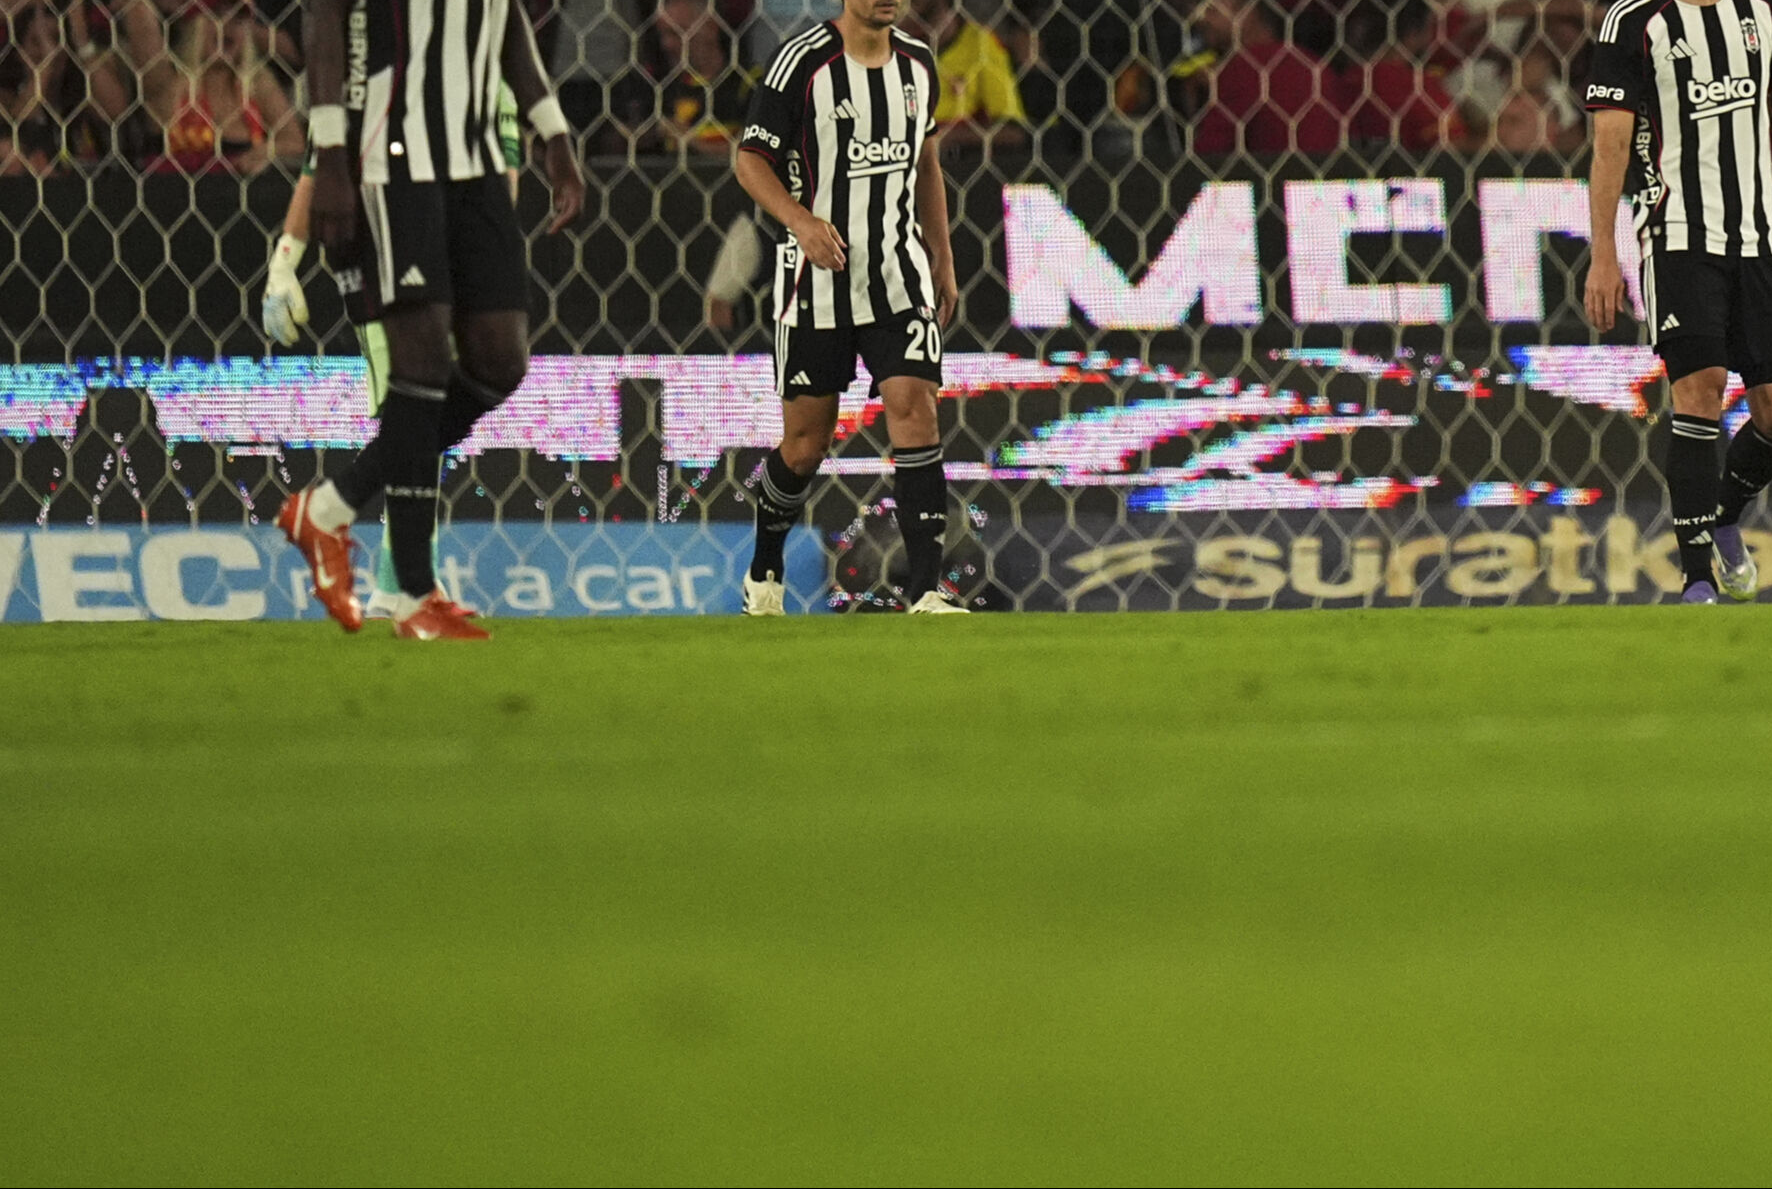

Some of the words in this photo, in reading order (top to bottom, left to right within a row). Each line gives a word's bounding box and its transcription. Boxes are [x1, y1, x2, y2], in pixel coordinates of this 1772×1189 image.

[1688, 75, 1757, 105] beko
[847, 137, 911, 162] beko
[904, 319, 942, 363] 20
[504, 563, 554, 611] a
[574, 563, 714, 611] car
